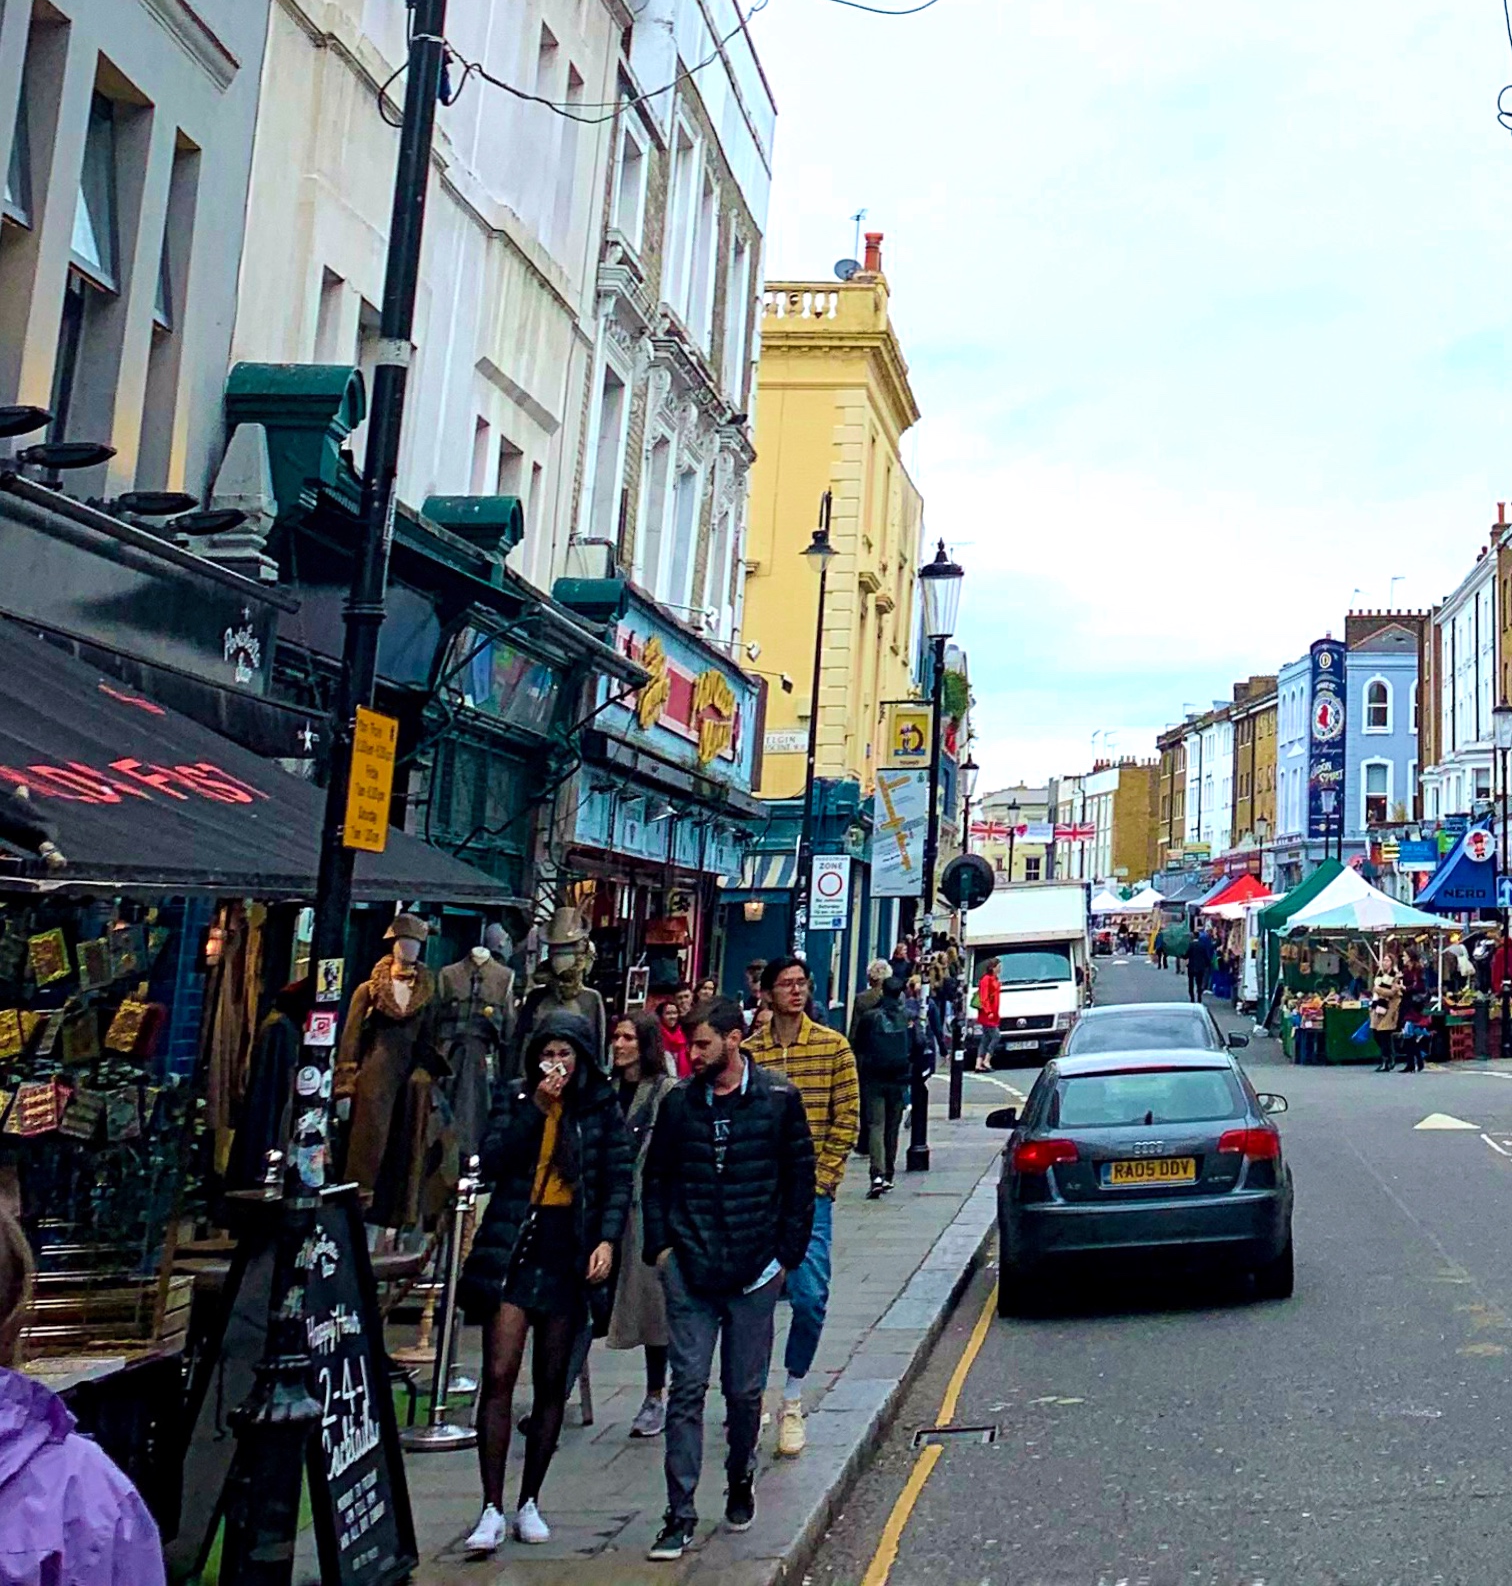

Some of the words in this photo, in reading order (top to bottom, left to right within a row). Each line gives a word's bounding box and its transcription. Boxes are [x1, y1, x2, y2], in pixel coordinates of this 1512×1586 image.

[766, 736, 796, 744] ELGIN
[819, 862, 843, 870] ZONE
[1114, 1162, 1156, 1180] RA05
[1159, 1159, 1191, 1178] DDV
